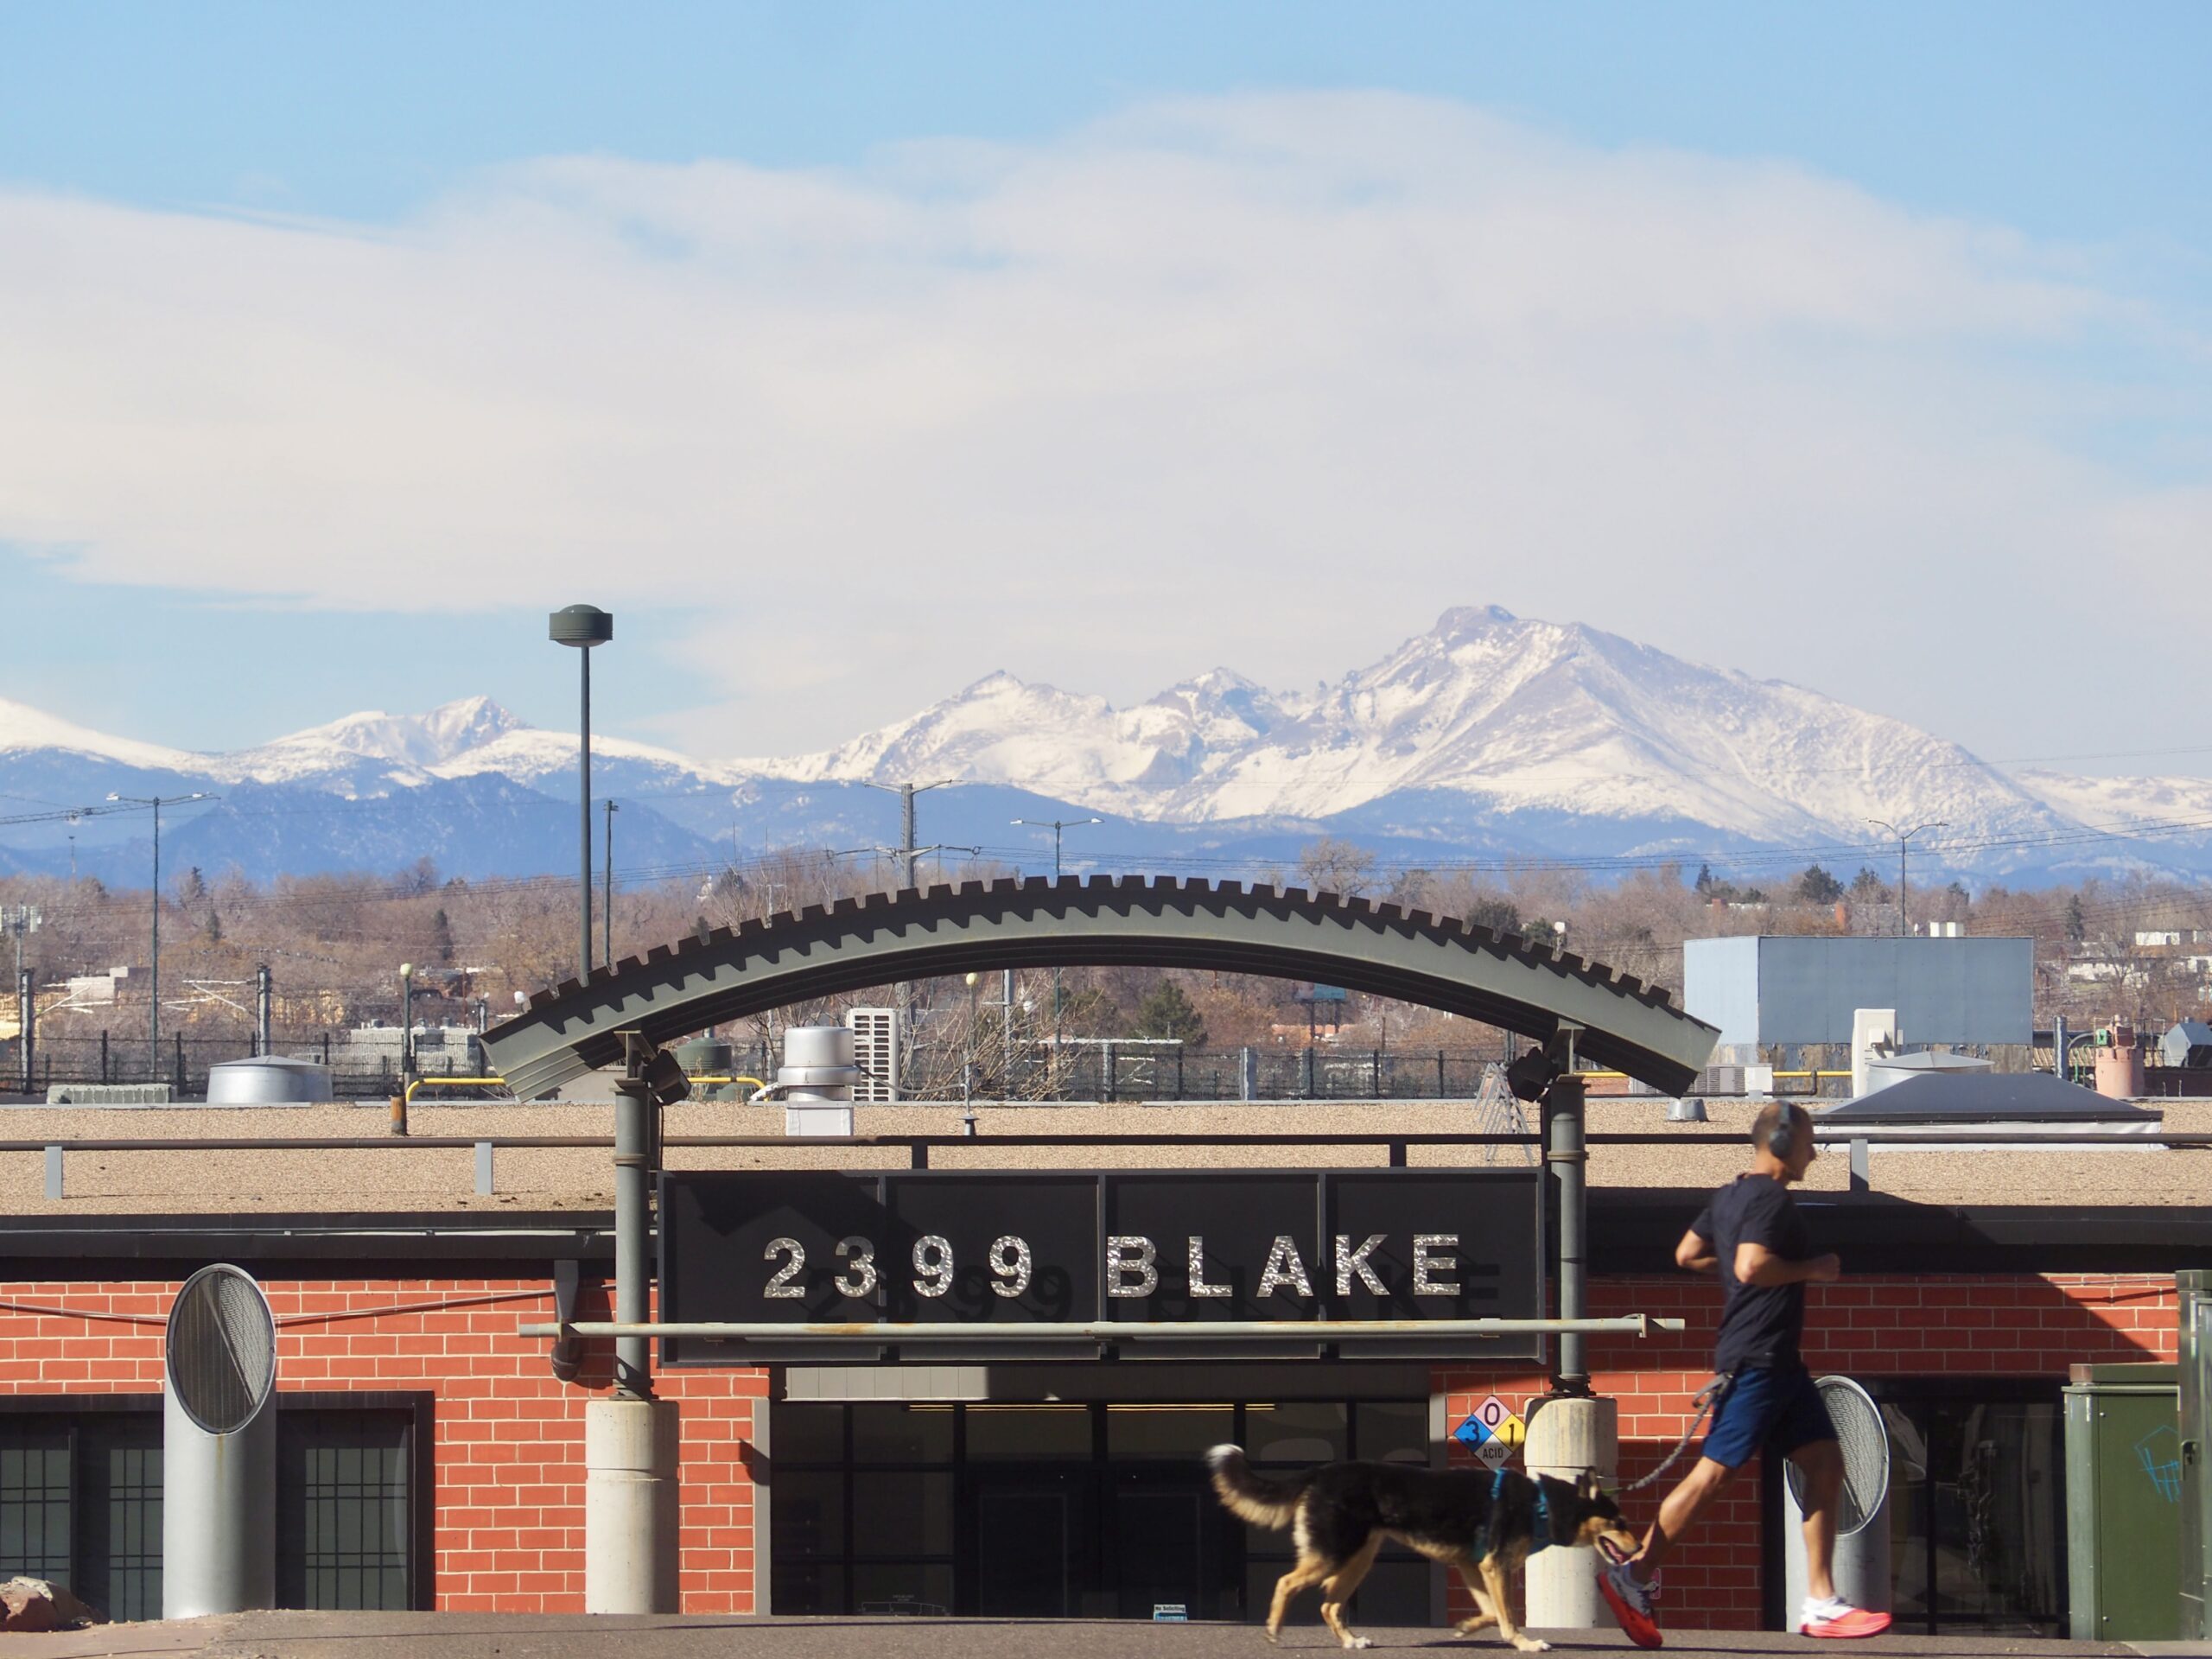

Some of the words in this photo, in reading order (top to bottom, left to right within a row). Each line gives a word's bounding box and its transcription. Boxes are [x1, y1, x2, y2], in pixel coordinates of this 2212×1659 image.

[763, 1235, 1032, 1298] 2399
[1107, 1234, 1461, 1297] BLAKE
[1484, 1403, 1500, 1426] 0
[1465, 1421, 1480, 1443] 3
[1509, 1423, 1515, 1446] 1
[1483, 1447, 1503, 1459] ACID
